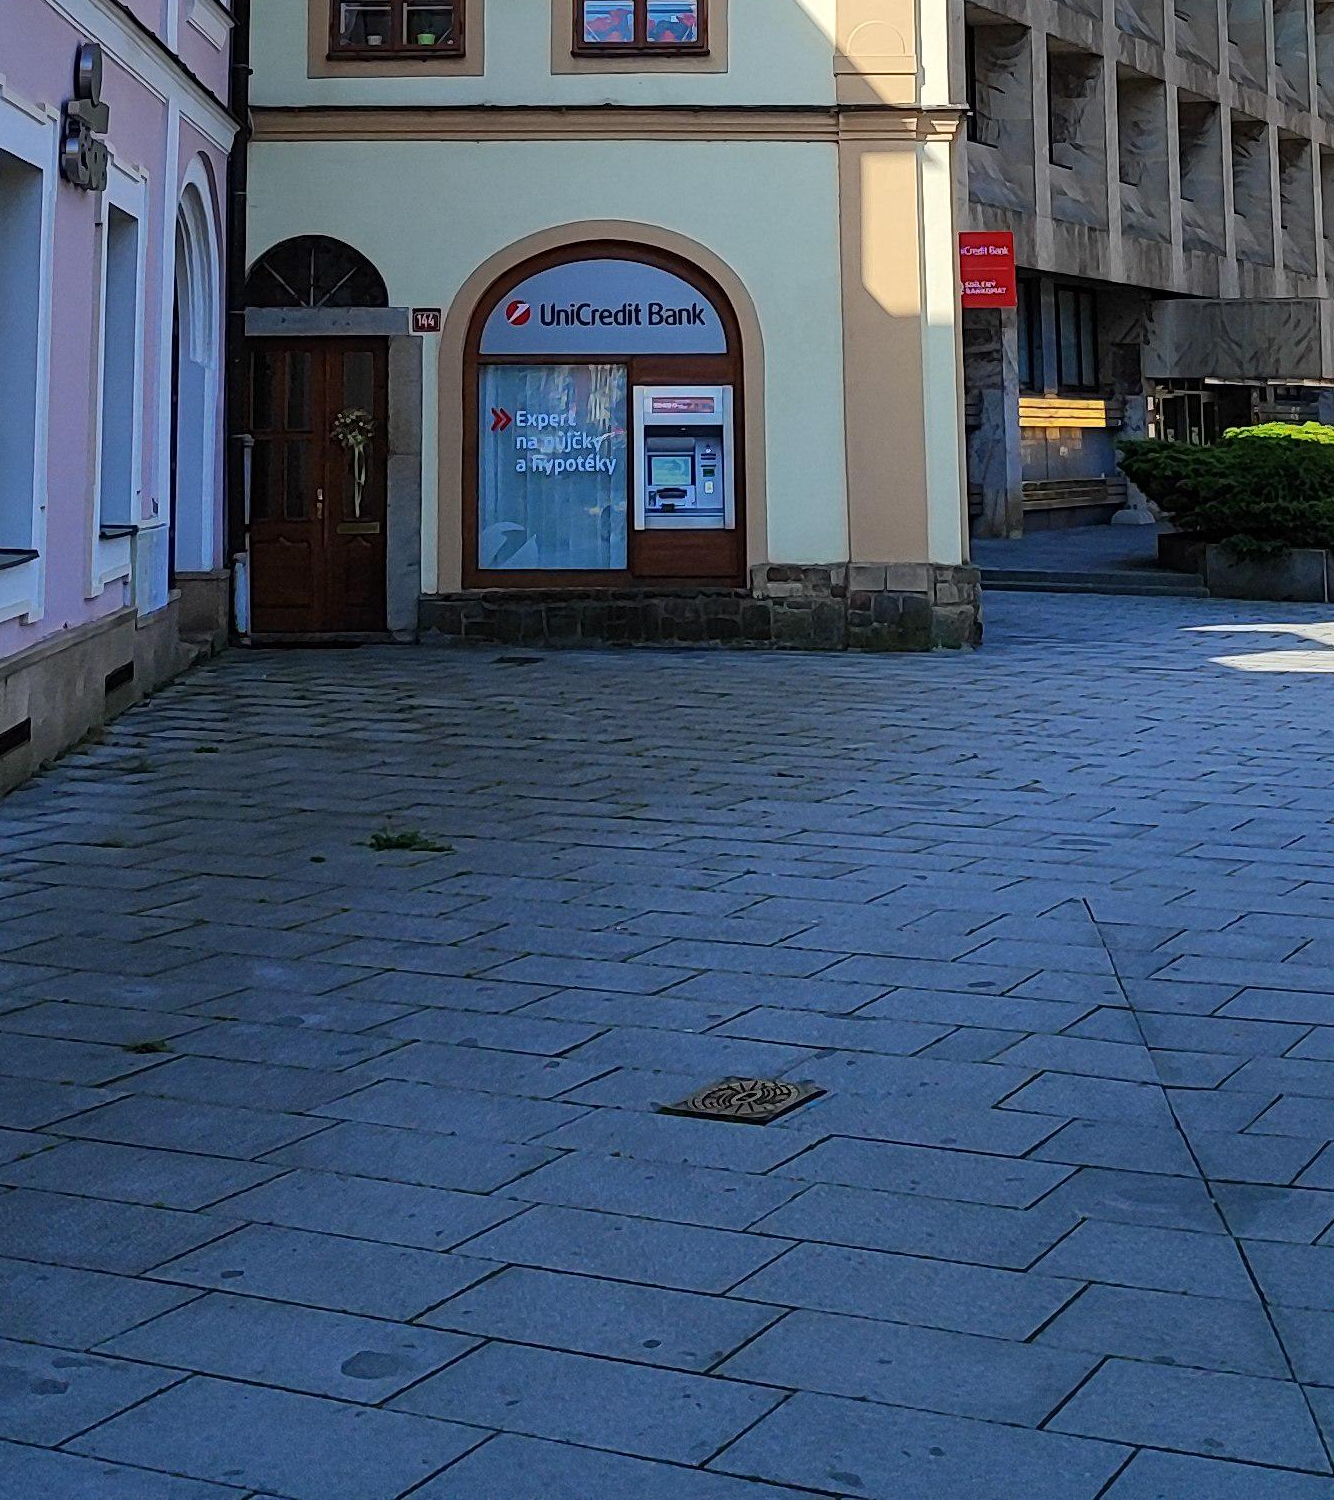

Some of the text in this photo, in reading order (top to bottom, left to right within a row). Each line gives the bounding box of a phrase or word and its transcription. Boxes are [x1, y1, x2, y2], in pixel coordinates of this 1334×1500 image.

[989, 246, 1009, 255] Bank
[416, 313, 435, 328] 144
[540, 302, 705, 327] UniCredit Bank
[516, 410, 577, 430] Expert
[516, 431, 603, 453] na půjčky
[516, 452, 617, 476] a hypotéky
